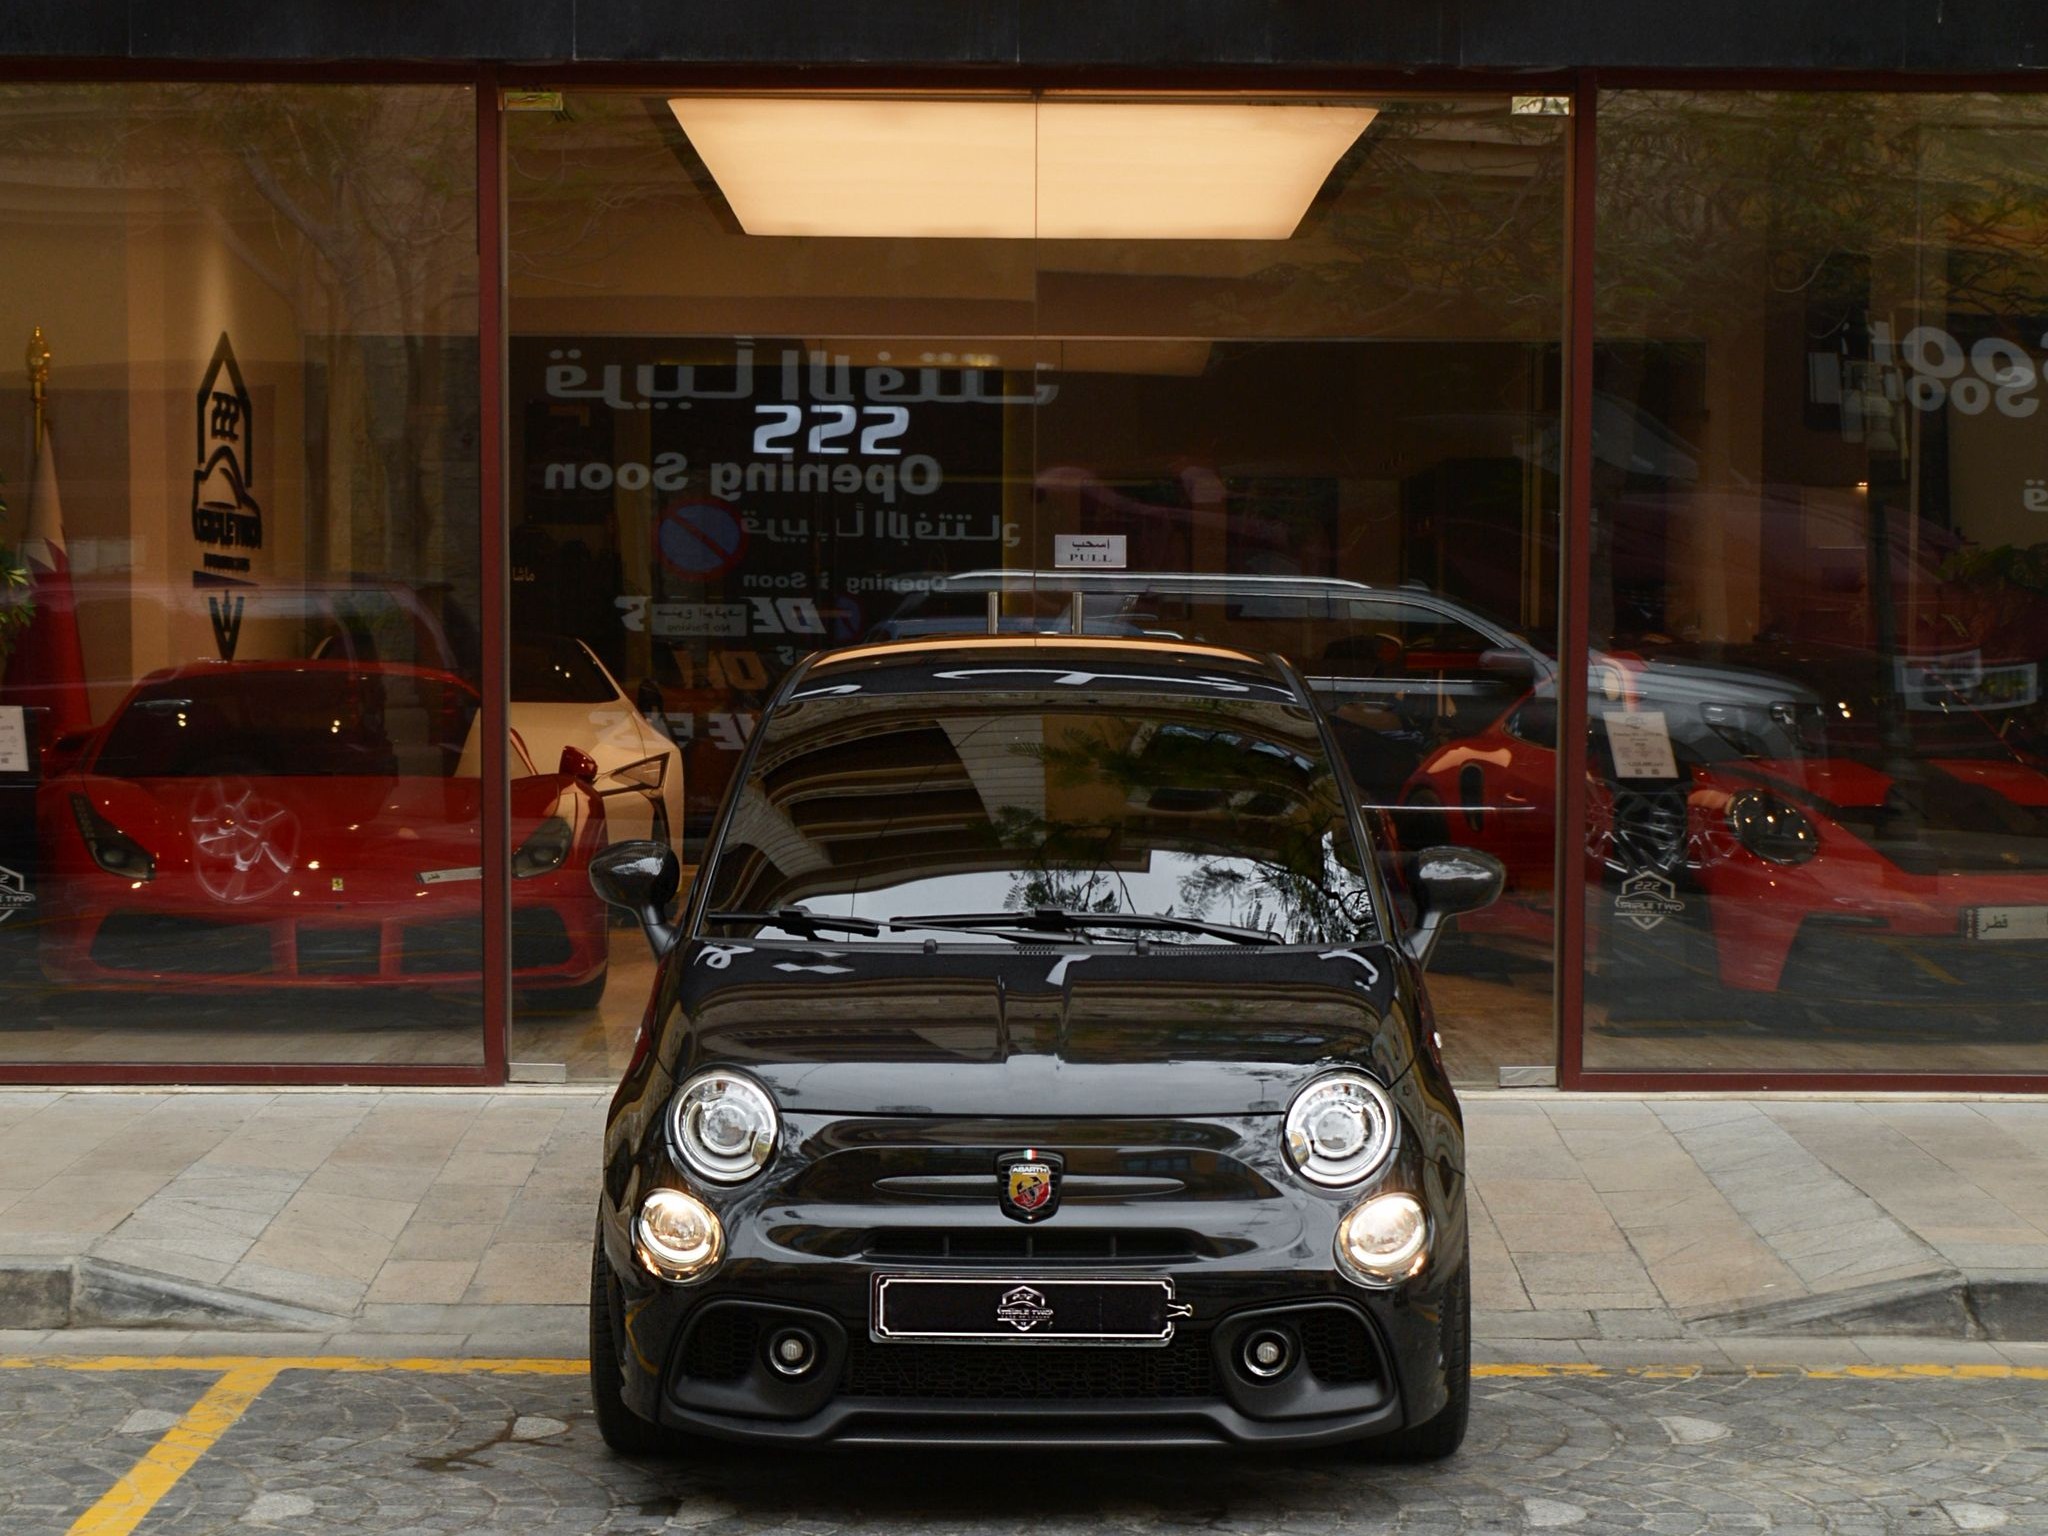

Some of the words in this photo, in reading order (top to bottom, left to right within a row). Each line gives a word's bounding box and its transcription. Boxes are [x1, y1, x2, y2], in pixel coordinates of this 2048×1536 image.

[752, 404, 910, 455] 222
[1070, 554, 1112, 562] PULL
[1633, 881, 1661, 890] 222
[1657, 901, 1682, 912] TWO
